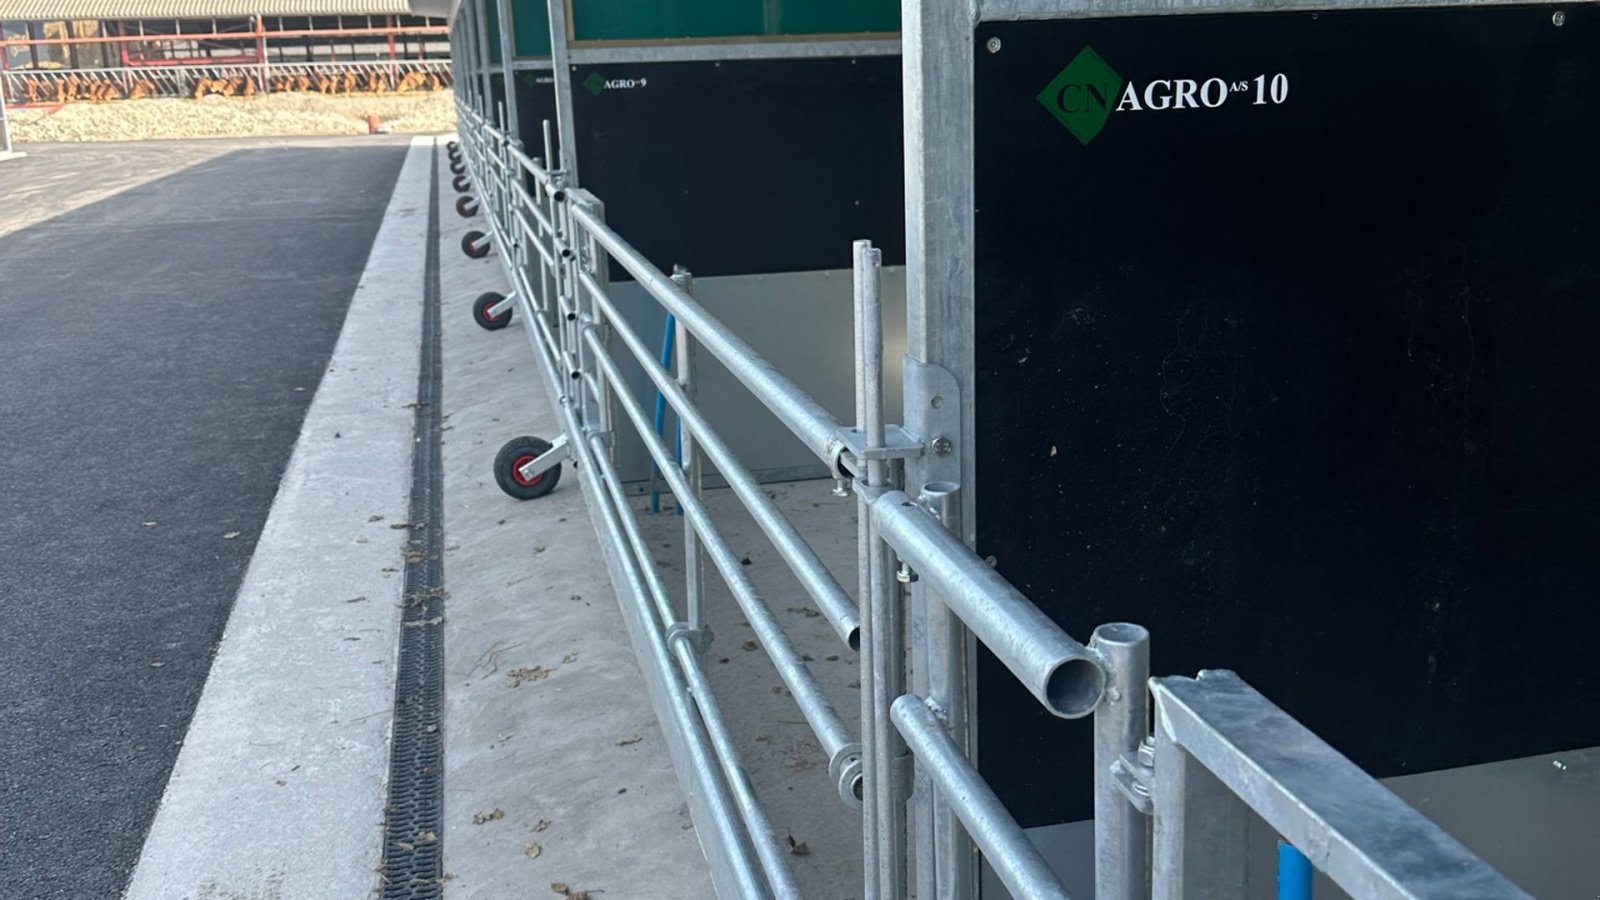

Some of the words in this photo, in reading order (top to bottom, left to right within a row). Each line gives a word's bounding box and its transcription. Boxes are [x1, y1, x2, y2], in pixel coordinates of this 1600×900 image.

[603, 79, 635, 90] AGRO
[640, 78, 647, 88] 9
[1056, 82, 1110, 114] CN
[1115, 77, 1228, 112] AGRO
[1229, 81, 1249, 93] A/S
[1252, 73, 1289, 106] 10
